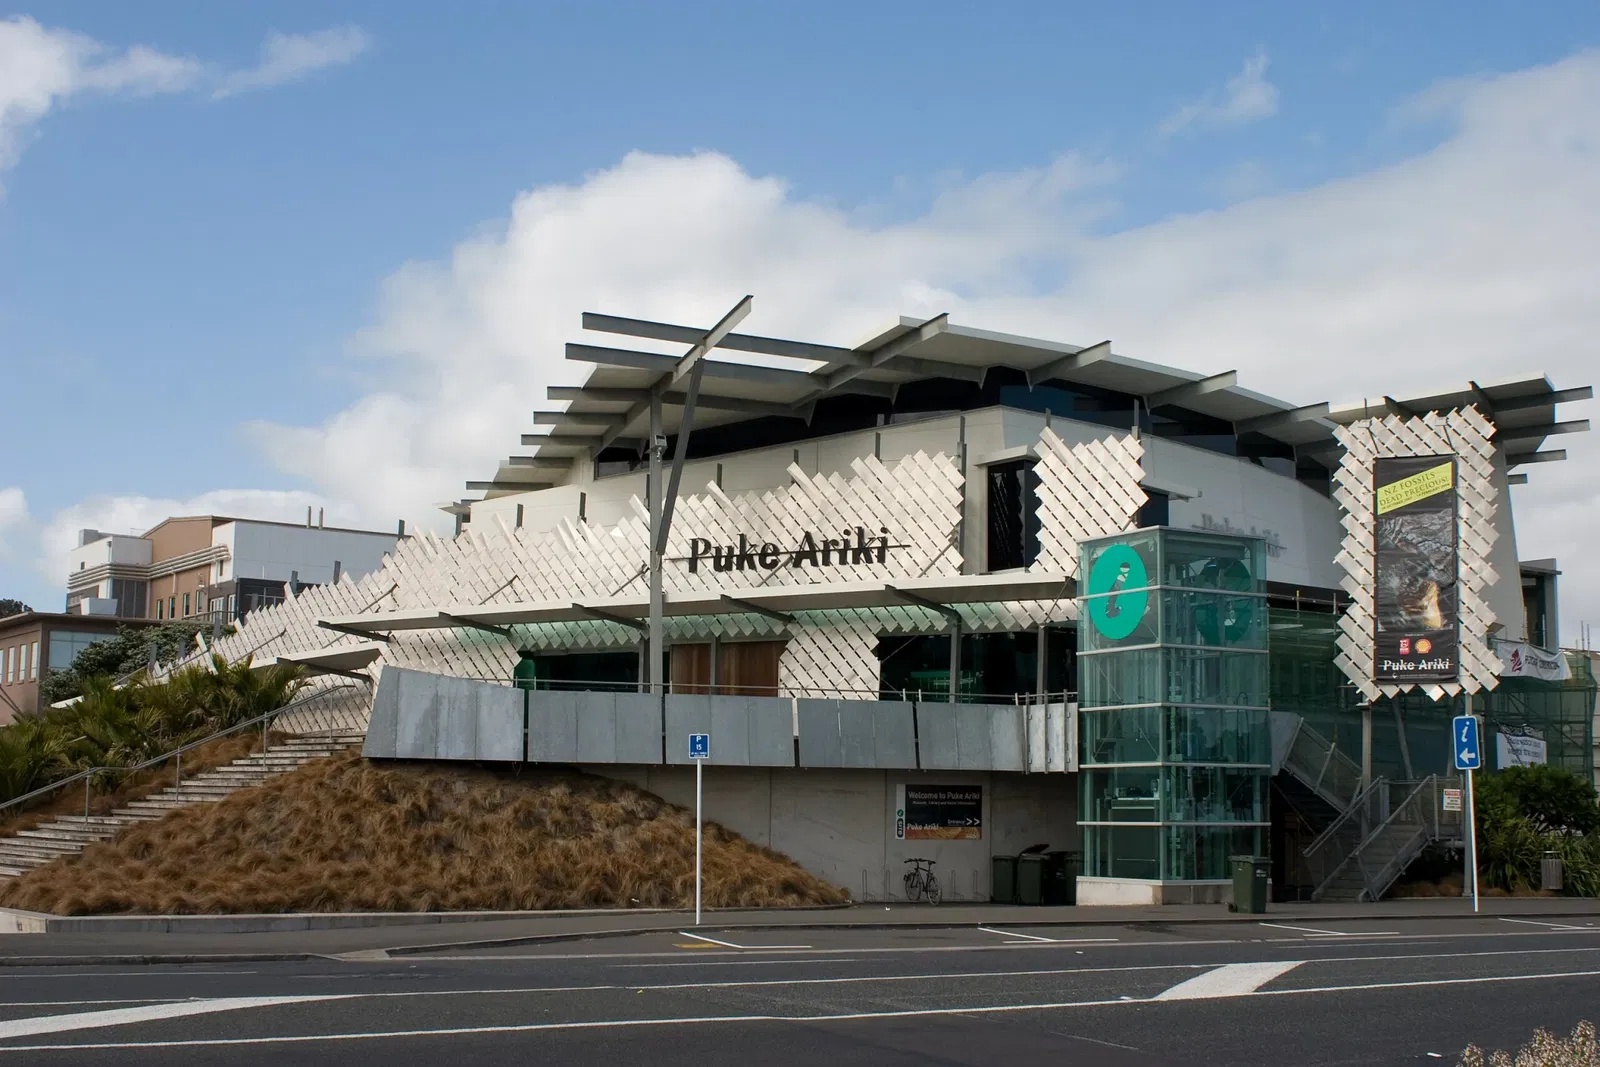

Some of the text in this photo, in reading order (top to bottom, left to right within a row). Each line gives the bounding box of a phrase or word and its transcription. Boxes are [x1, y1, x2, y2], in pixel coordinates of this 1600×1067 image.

[1400, 472, 1436, 490] FOSSILS
[1379, 493, 1402, 506] DEAD
[688, 526, 888, 574] Puke Ariki
[1383, 658, 1450, 671] Puke Ariki
[908, 791, 938, 799] Welcome
[947, 791, 964, 799] Puke
[964, 791, 980, 800] Ariki
[907, 823, 940, 831] Puke Ariki
